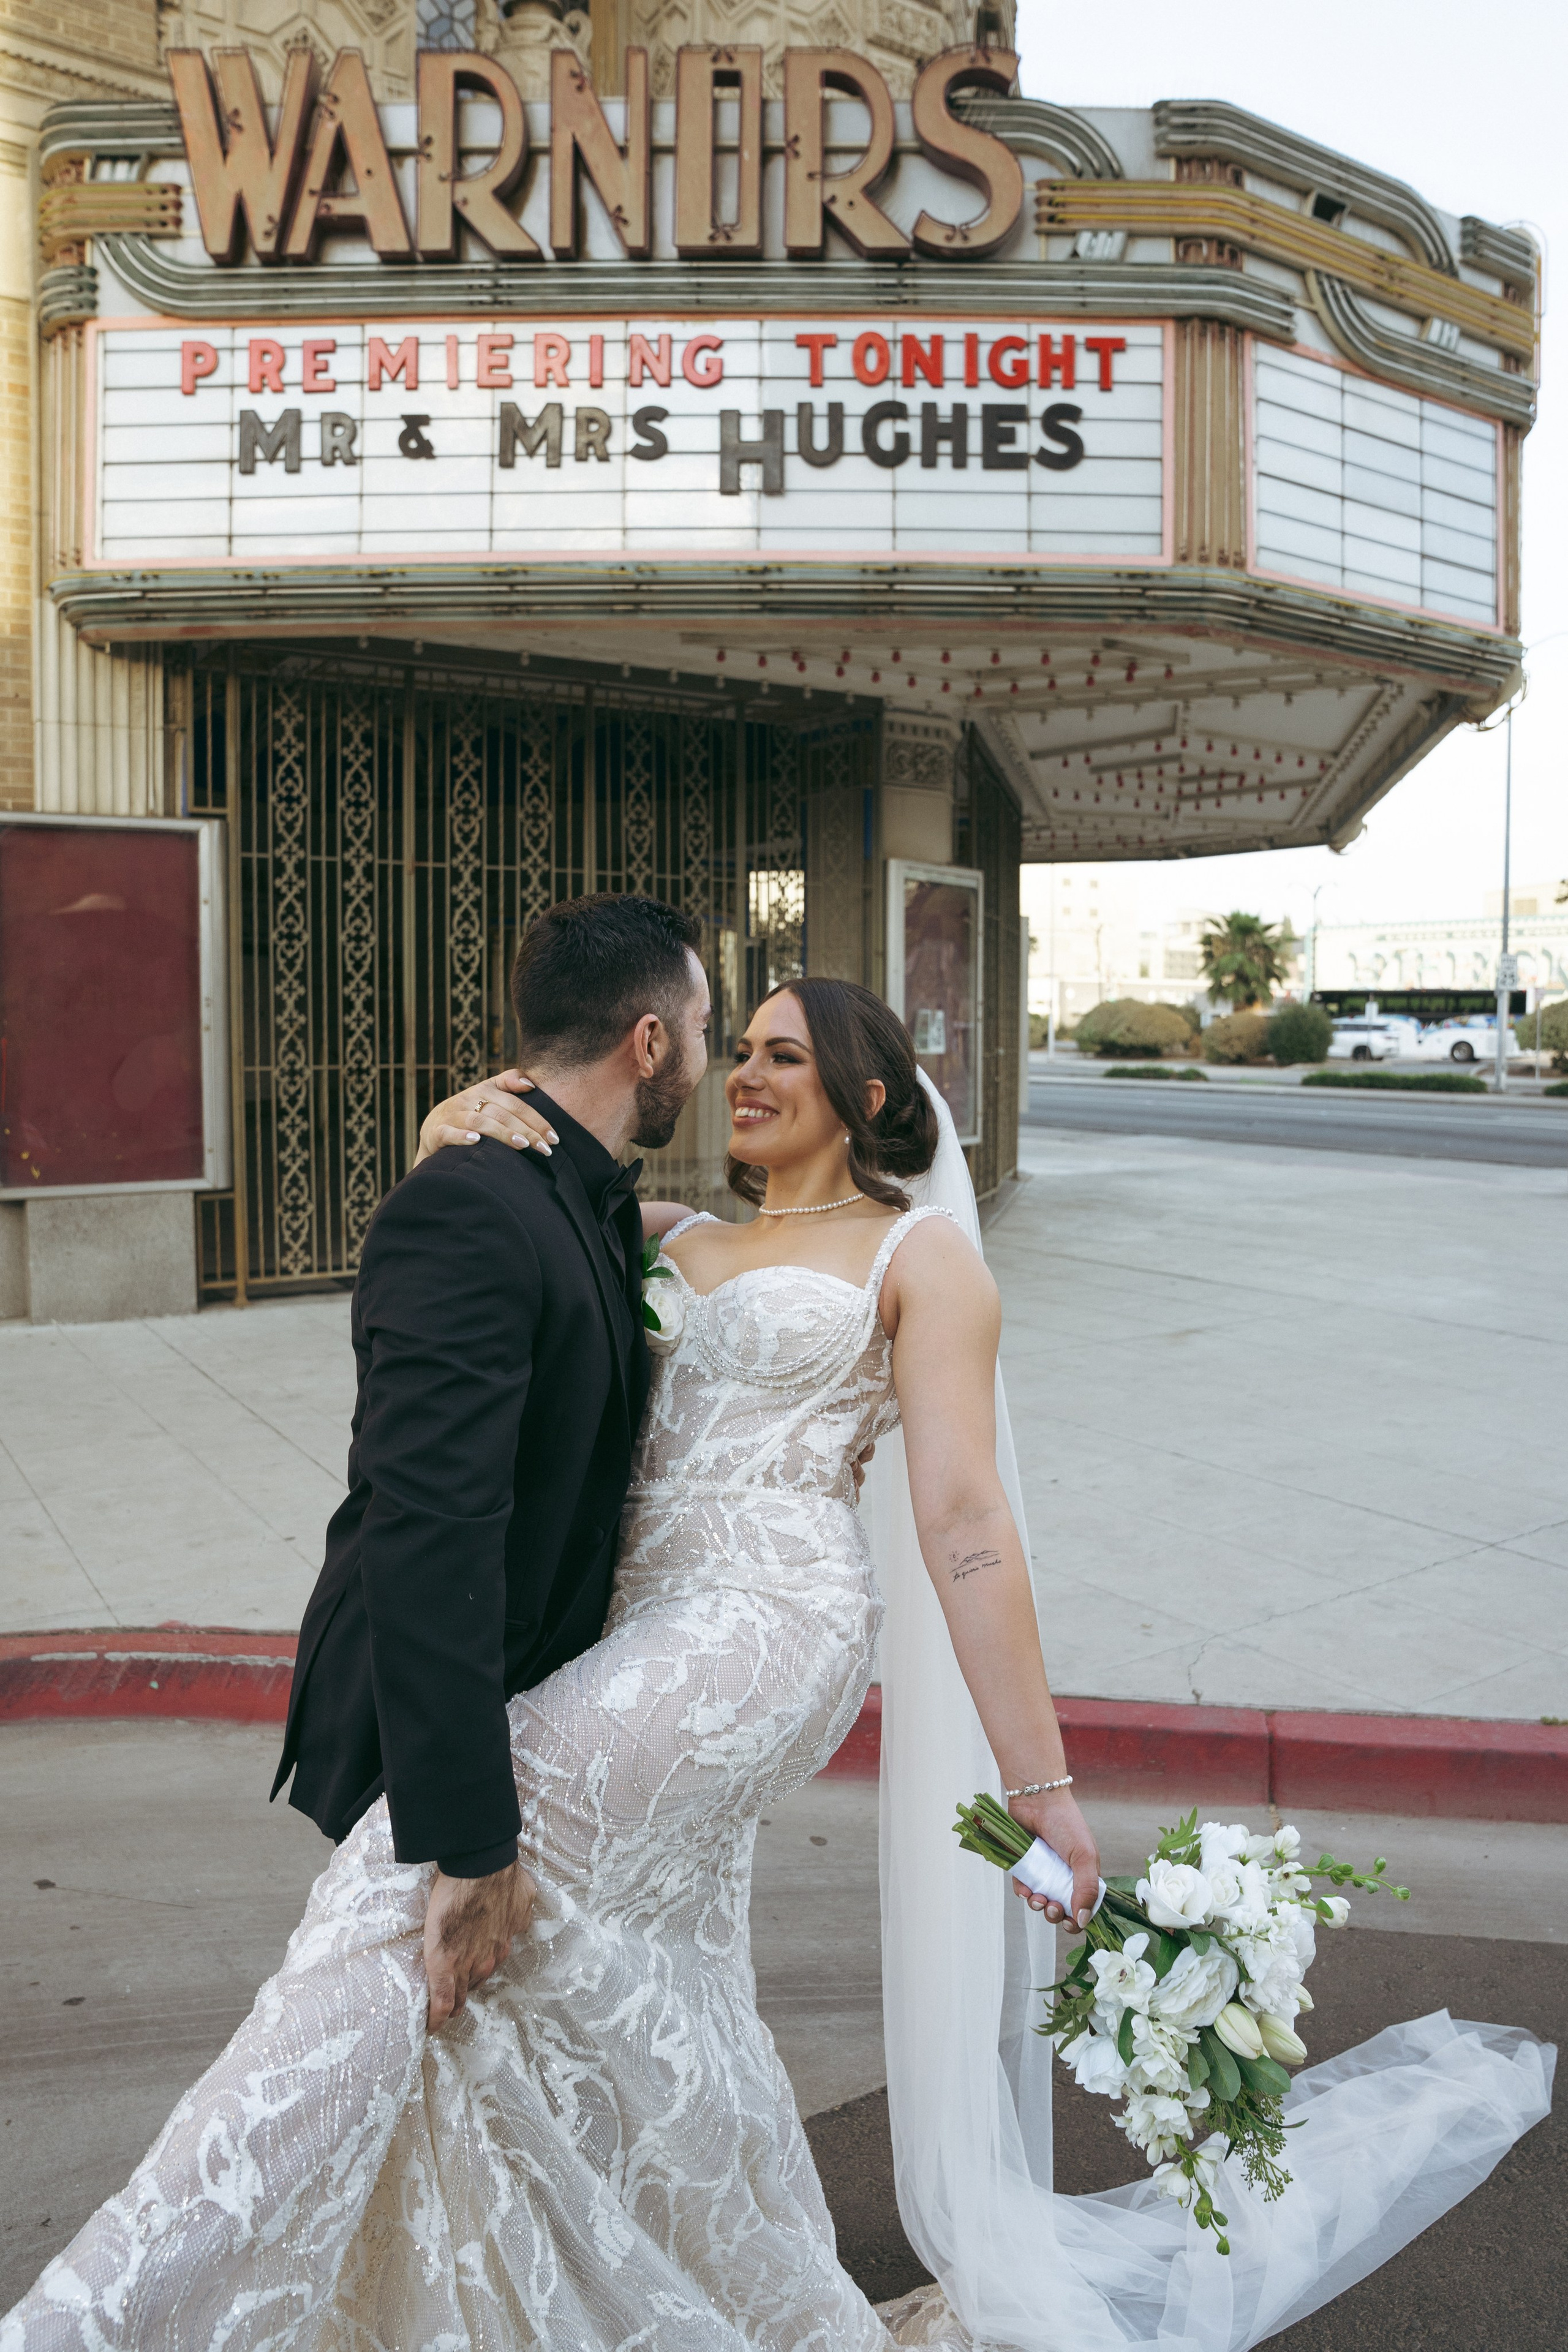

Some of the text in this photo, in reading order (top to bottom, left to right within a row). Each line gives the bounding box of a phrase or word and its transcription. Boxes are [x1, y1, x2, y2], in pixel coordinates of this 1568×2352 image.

[168, 46, 1022, 263] WARNORS
[180, 331, 1126, 395] PREMIERING TONIGHT
[238, 400, 1085, 496] MR & MRS HUGHES
